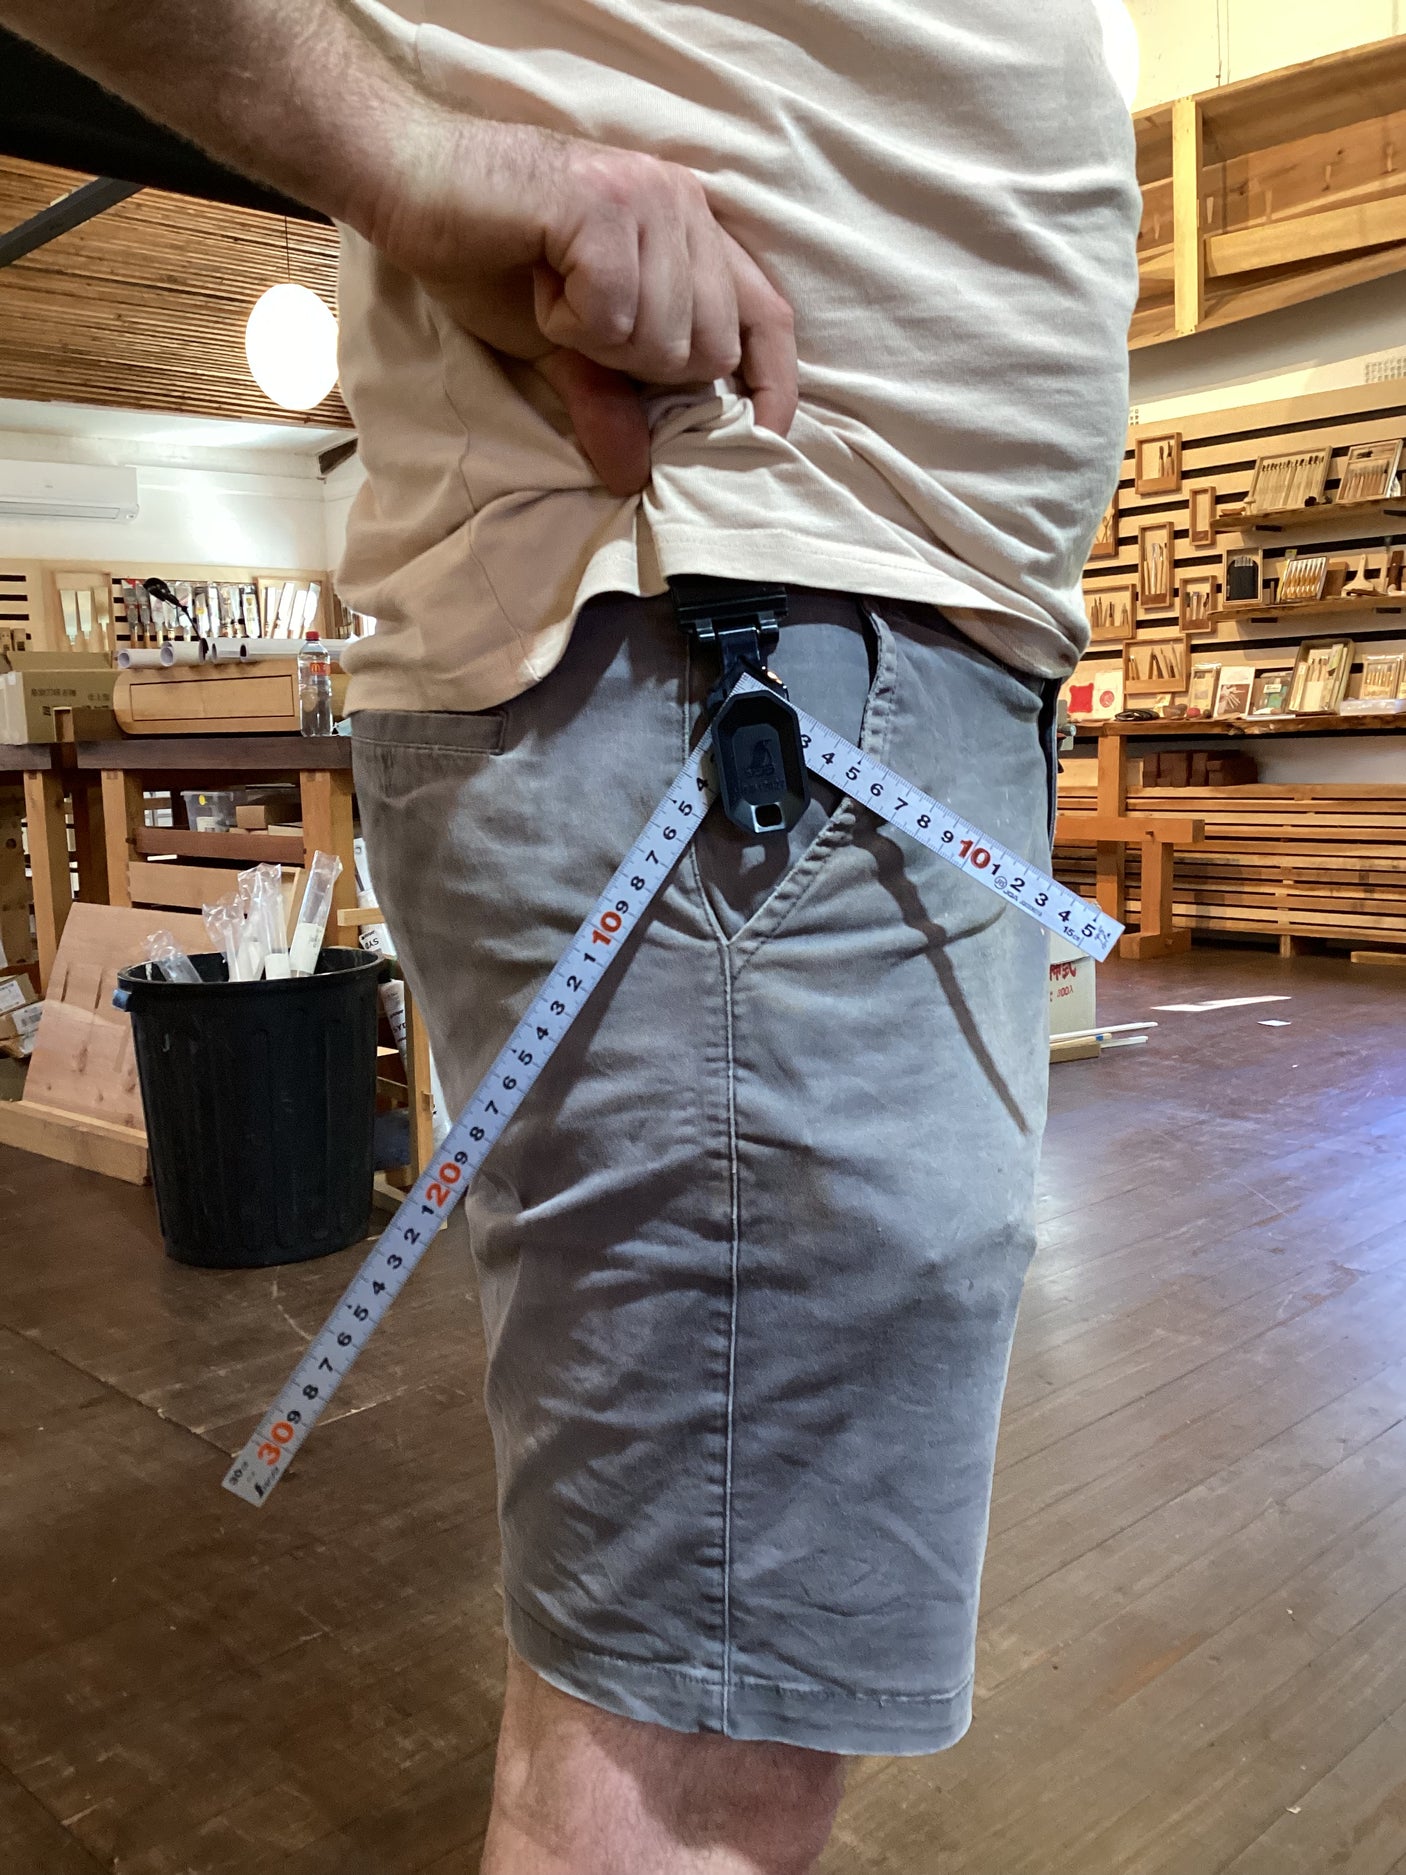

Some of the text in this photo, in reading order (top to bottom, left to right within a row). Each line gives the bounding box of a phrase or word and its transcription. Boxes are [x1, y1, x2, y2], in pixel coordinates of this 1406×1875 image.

[696, 776, 710, 793] 4
[677, 800, 693, 817] 5
[663, 825, 677, 841] 6
[801, 733, 812, 749] 3
[821, 752, 835, 765] 4
[845, 766, 861, 781] 5
[870, 783, 884, 797] 6
[894, 797, 909, 811] 7
[916, 814, 931, 829] 8
[941, 830, 954, 843] 9
[958, 839, 991, 869] 10
[991, 863, 1002, 877] 1
[1009, 877, 1026, 893] 2
[1034, 892, 1049, 907] 3
[1058, 910, 1071, 923] 4
[1081, 923, 1096, 938] 5
[645, 849, 659, 865] 7
[630, 875, 645, 891] 8
[615, 900, 629, 915] 9
[592, 911, 622, 946] 10
[583, 952, 597, 963] 1
[566, 975, 583, 993] 2
[550, 1000, 565, 1016] 3
[536, 1026, 549, 1041] 4
[517, 1049, 533, 1066] 5
[502, 1075, 517, 1090] 6
[484, 1099, 499, 1115] 7
[469, 1126, 485, 1142] 8
[454, 1151, 468, 1165] 9
[425, 1161, 462, 1208] 20
[421, 1205, 435, 1215] 1
[403, 1227, 421, 1245] 2
[387, 1254, 403, 1269] 3
[372, 1281, 386, 1295] 4
[353, 1305, 369, 1321] 5
[337, 1332, 352, 1347] 6
[318, 1357, 333, 1372] 7
[302, 1384, 319, 1401] 8
[286, 1409, 302, 1425] 9
[257, 1420, 295, 1467] 30
